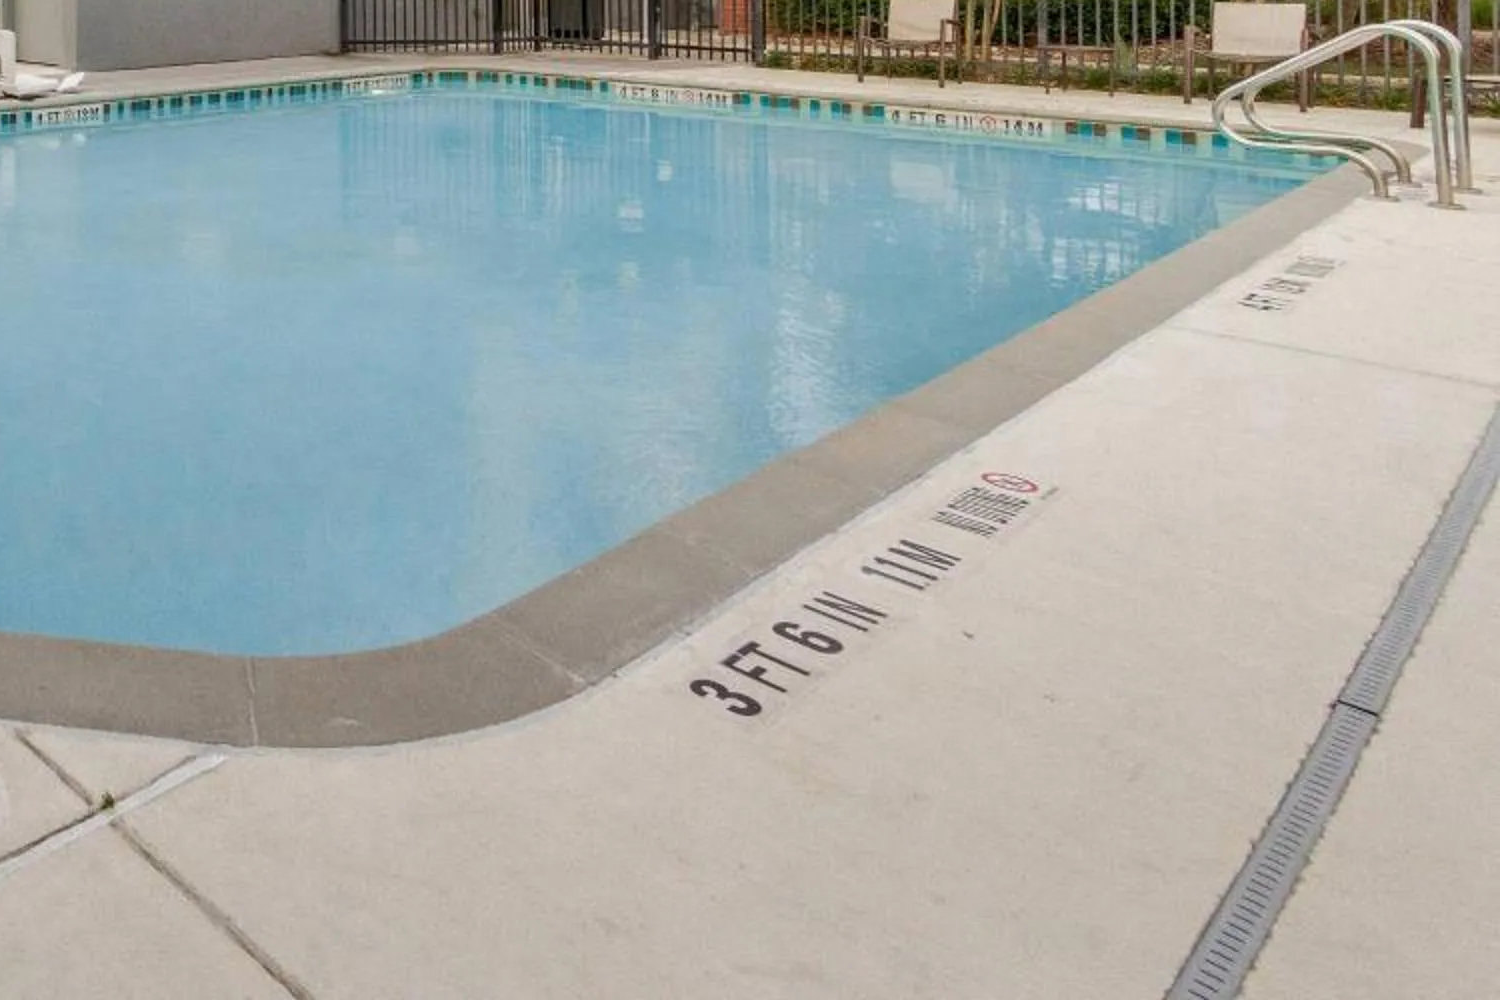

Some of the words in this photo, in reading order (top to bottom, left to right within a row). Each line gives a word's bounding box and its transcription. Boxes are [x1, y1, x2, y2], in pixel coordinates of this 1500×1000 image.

[802, 591, 889, 632] IN
[772, 621, 844, 654] 6
[720, 641, 811, 692] FT
[689, 679, 762, 716] 3
